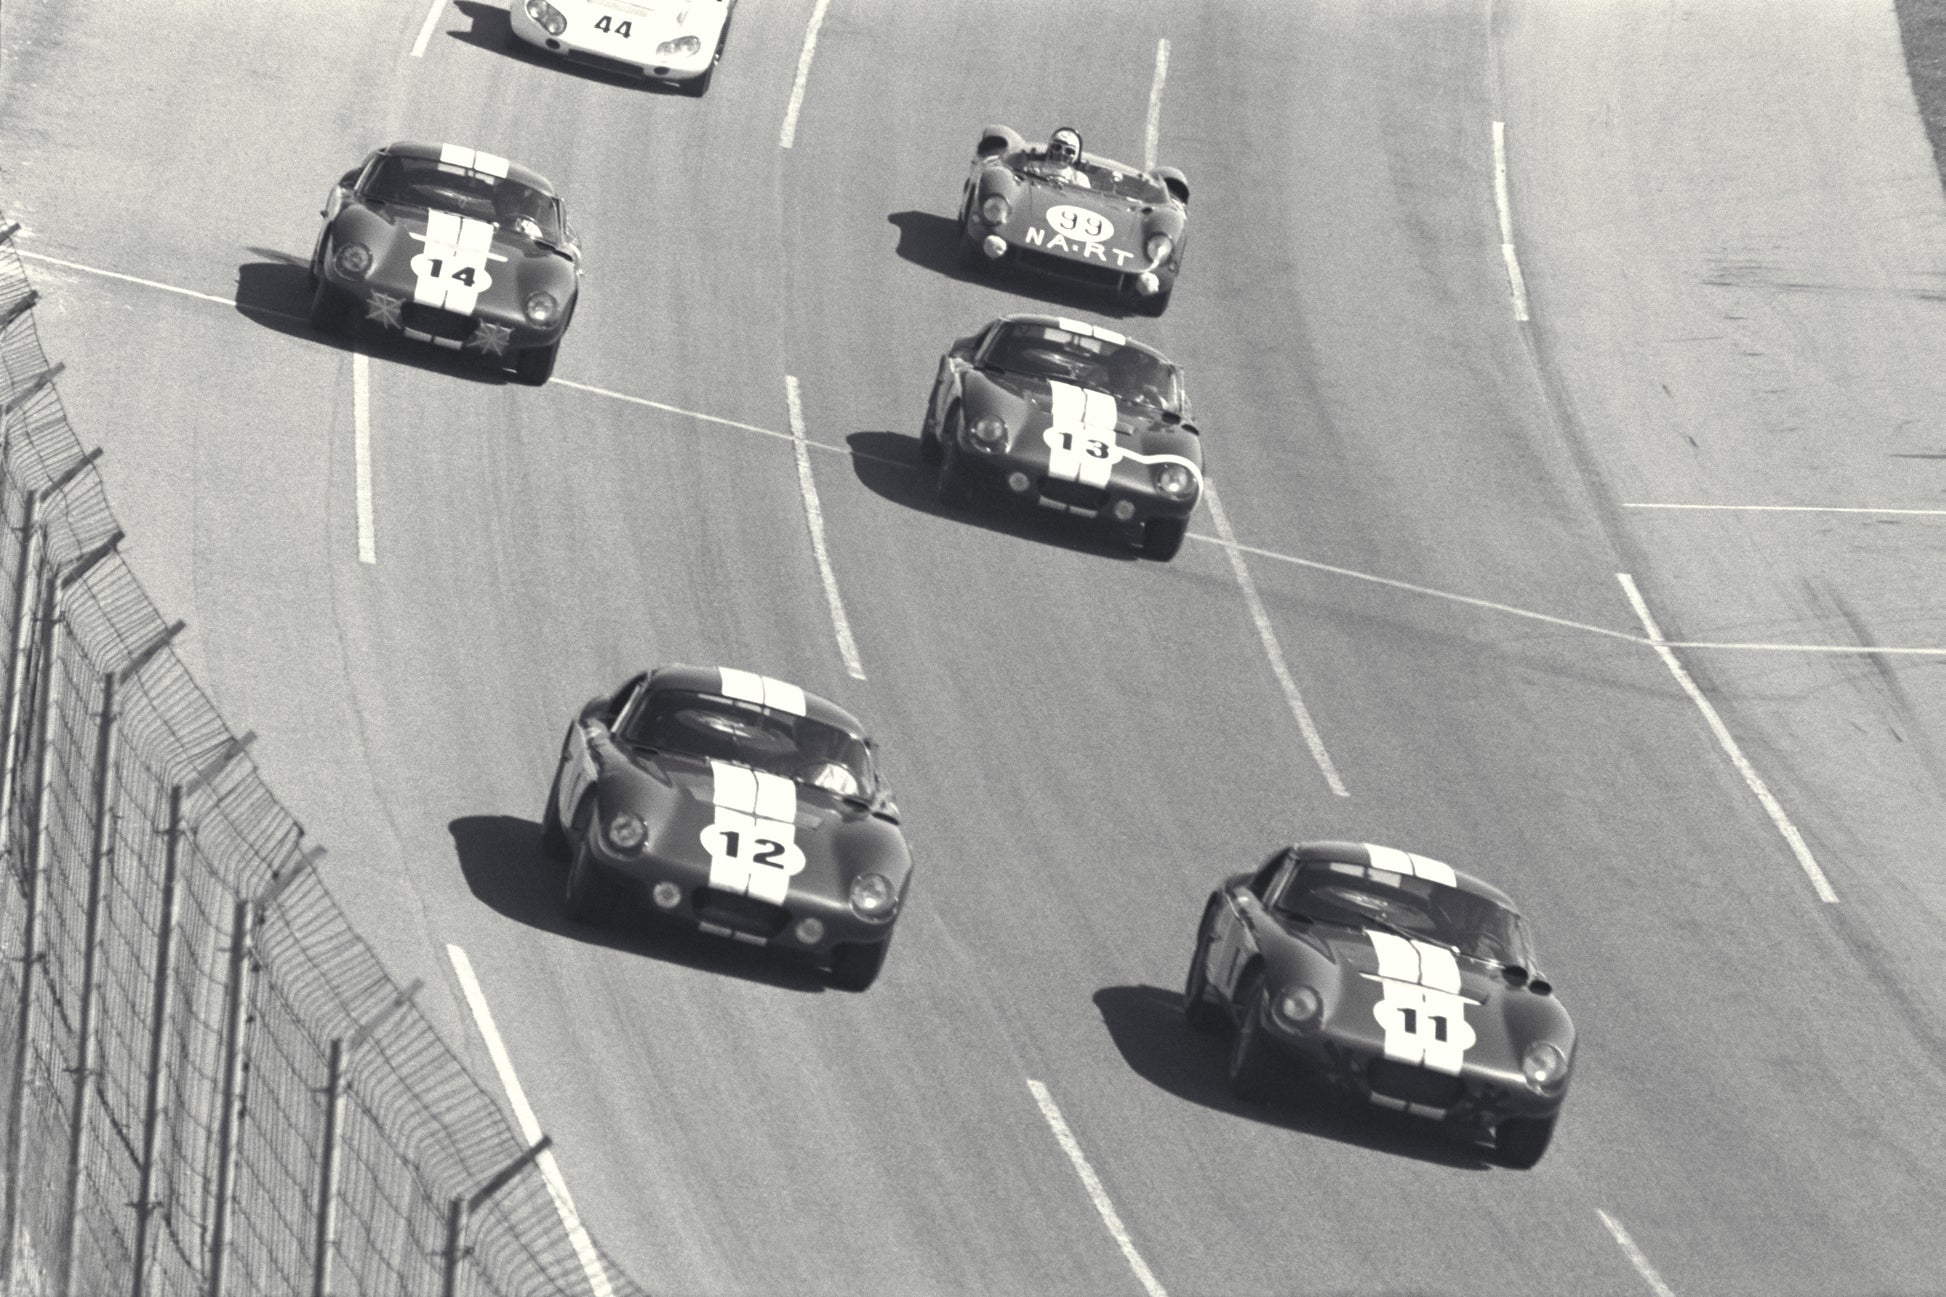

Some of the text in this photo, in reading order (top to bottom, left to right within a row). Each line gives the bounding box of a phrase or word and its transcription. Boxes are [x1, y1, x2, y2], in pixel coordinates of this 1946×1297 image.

[594, 15, 632, 39] 44
[1059, 210, 1103, 237] 99
[427, 258, 476, 287] 14
[1058, 432, 1110, 459] 13
[719, 831, 785, 870] 12
[1397, 1008, 1447, 1043] 11
